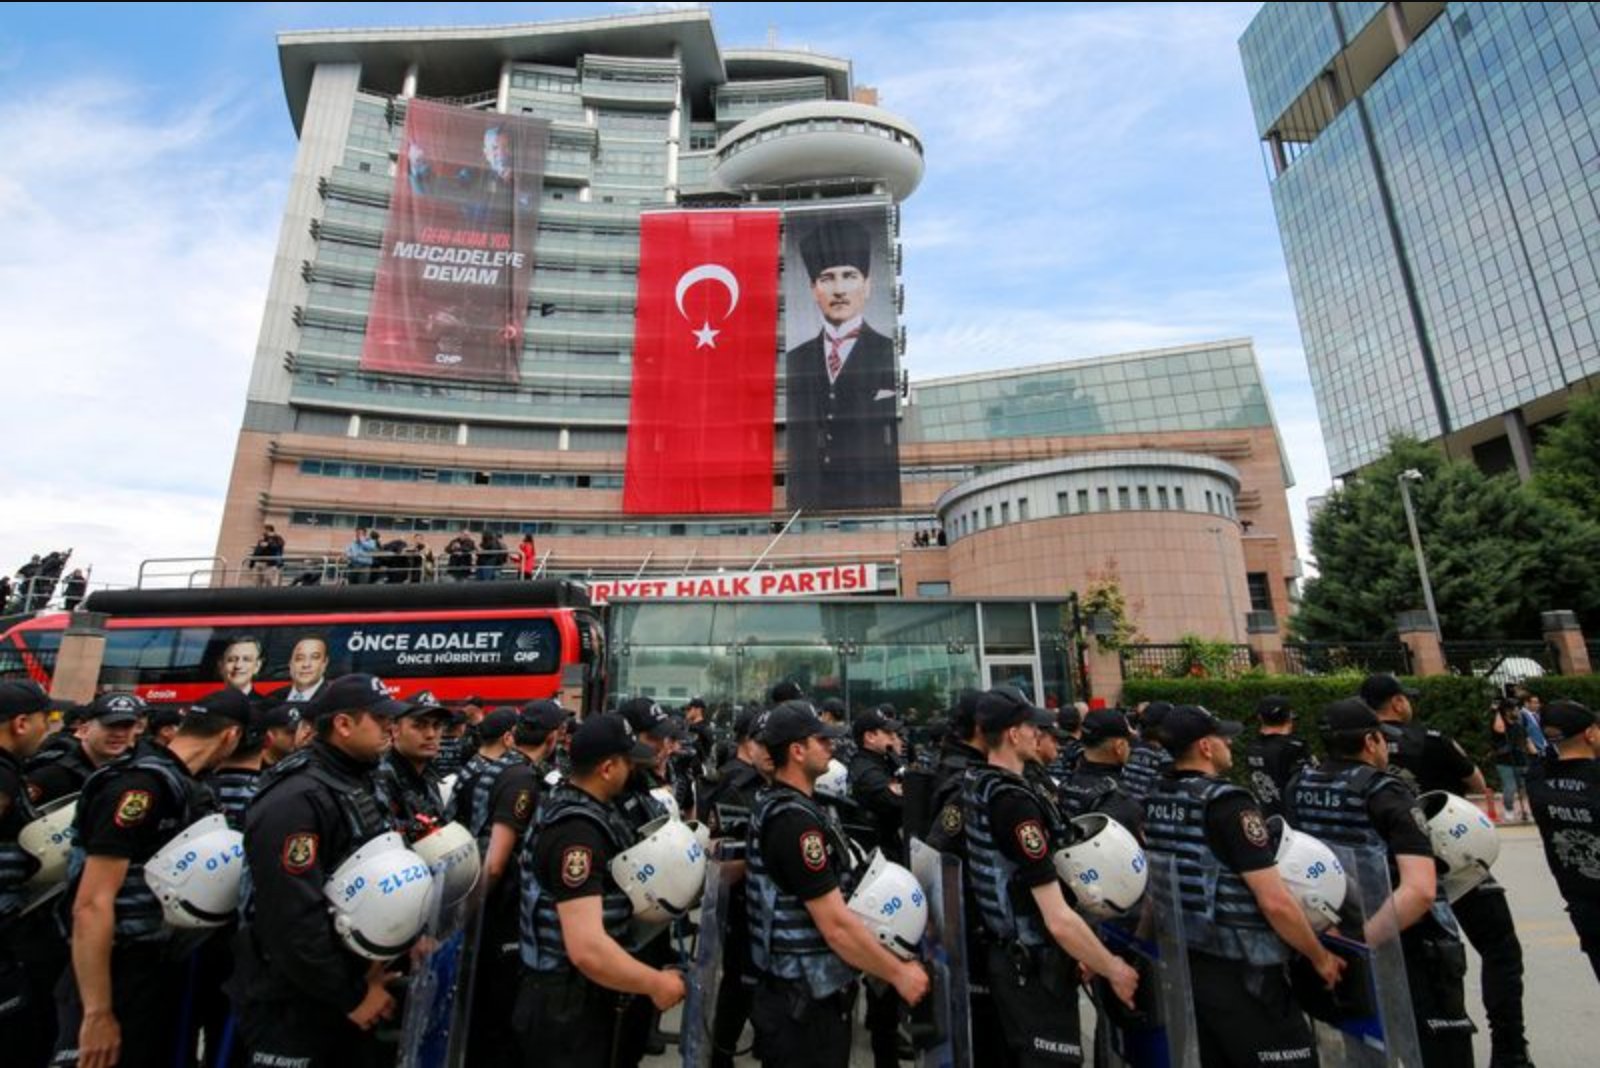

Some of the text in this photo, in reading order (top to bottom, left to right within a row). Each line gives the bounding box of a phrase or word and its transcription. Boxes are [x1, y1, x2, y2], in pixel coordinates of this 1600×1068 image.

[422, 263, 499, 285] DEVAM
[676, 577, 750, 597] HALK
[760, 564, 867, 595] PARTİSİ
[347, 631, 503, 651] ÖNCE ADALET
[397, 651, 432, 664] ÖNCE
[513, 652, 540, 662] CHP
[1147, 803, 1185, 821] POLİS
[636, 863, 656, 885] 06
[1080, 868, 1099, 885] 06
[1307, 860, 1327, 879] 06
[346, 876, 365, 898] 06
[885, 896, 903, 917] 06
